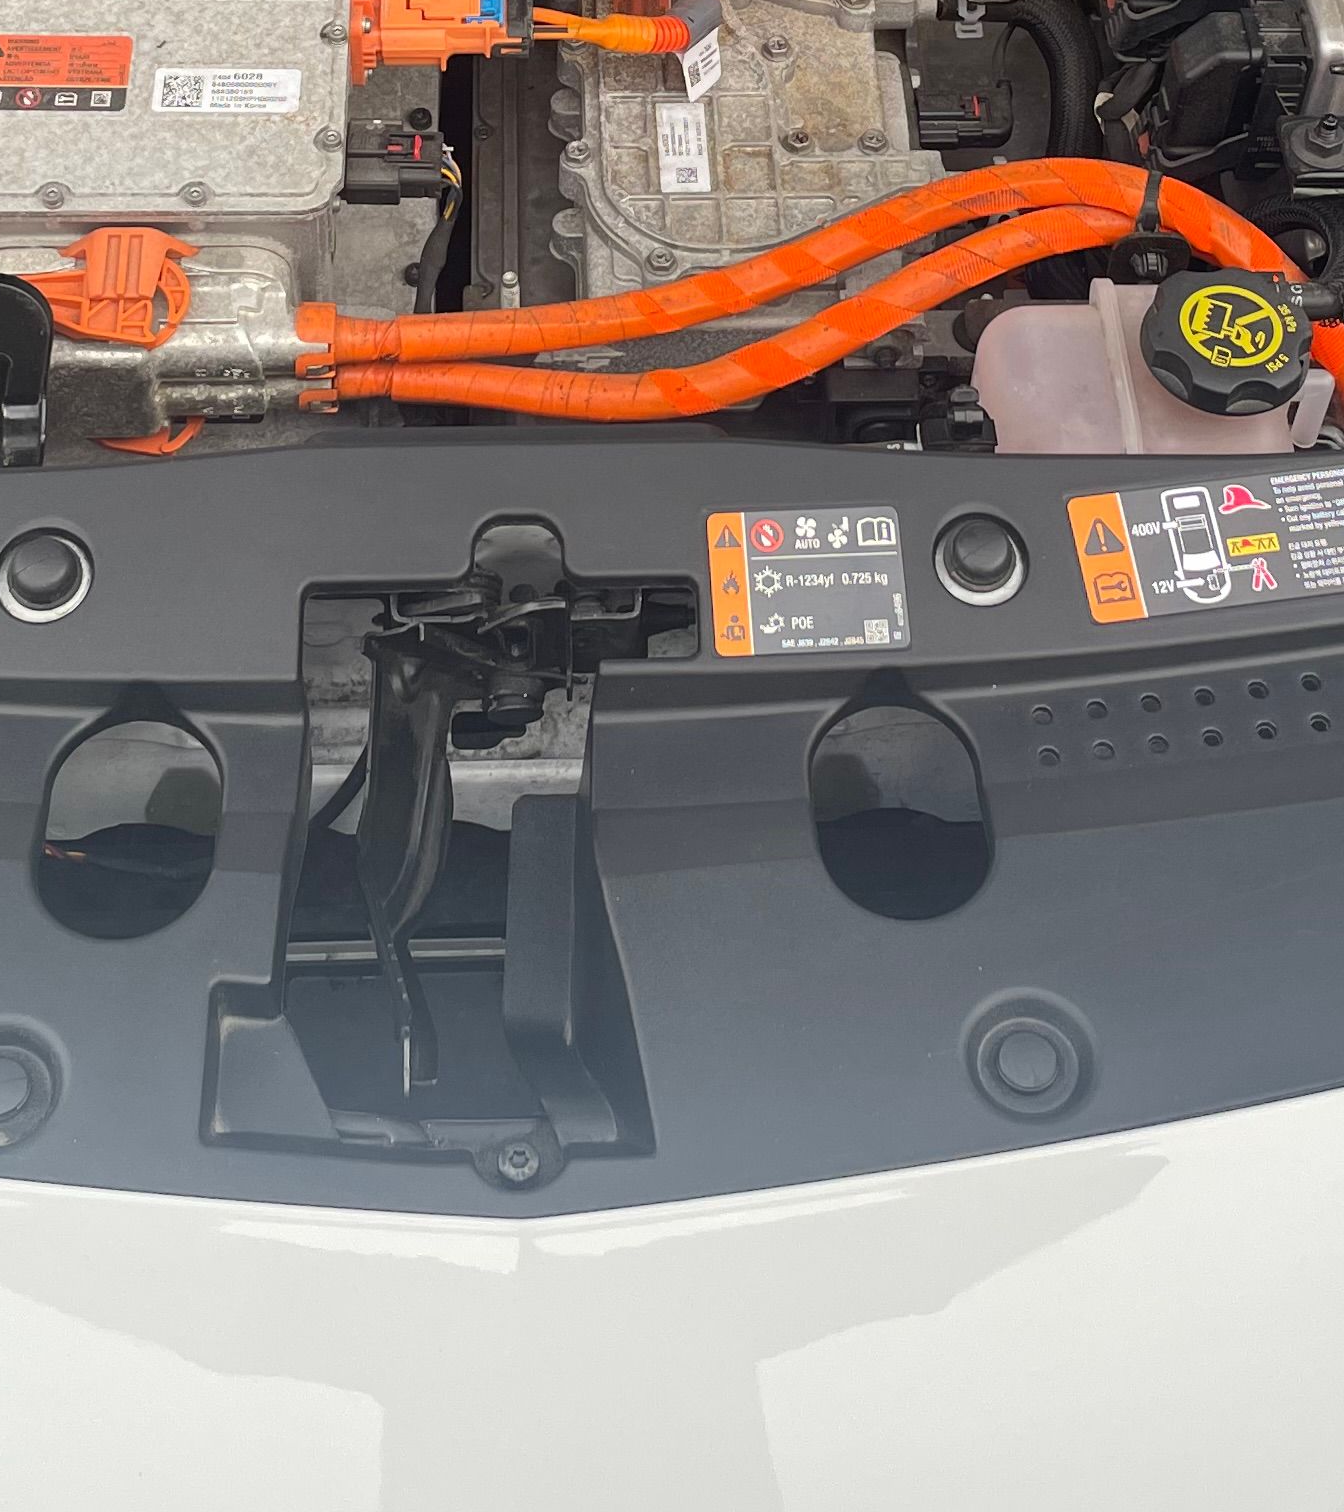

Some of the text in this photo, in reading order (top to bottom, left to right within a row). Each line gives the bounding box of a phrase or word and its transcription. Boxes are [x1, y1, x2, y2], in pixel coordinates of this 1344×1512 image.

[1265, 353, 1289, 373] 5 PSI
[1131, 522, 1160, 536] 400V
[795, 538, 820, 550] AUTO
[785, 572, 889, 588] R-1234yf 0.725 kg
[1152, 579, 1175, 594] 12V
[791, 616, 814, 630] POE
